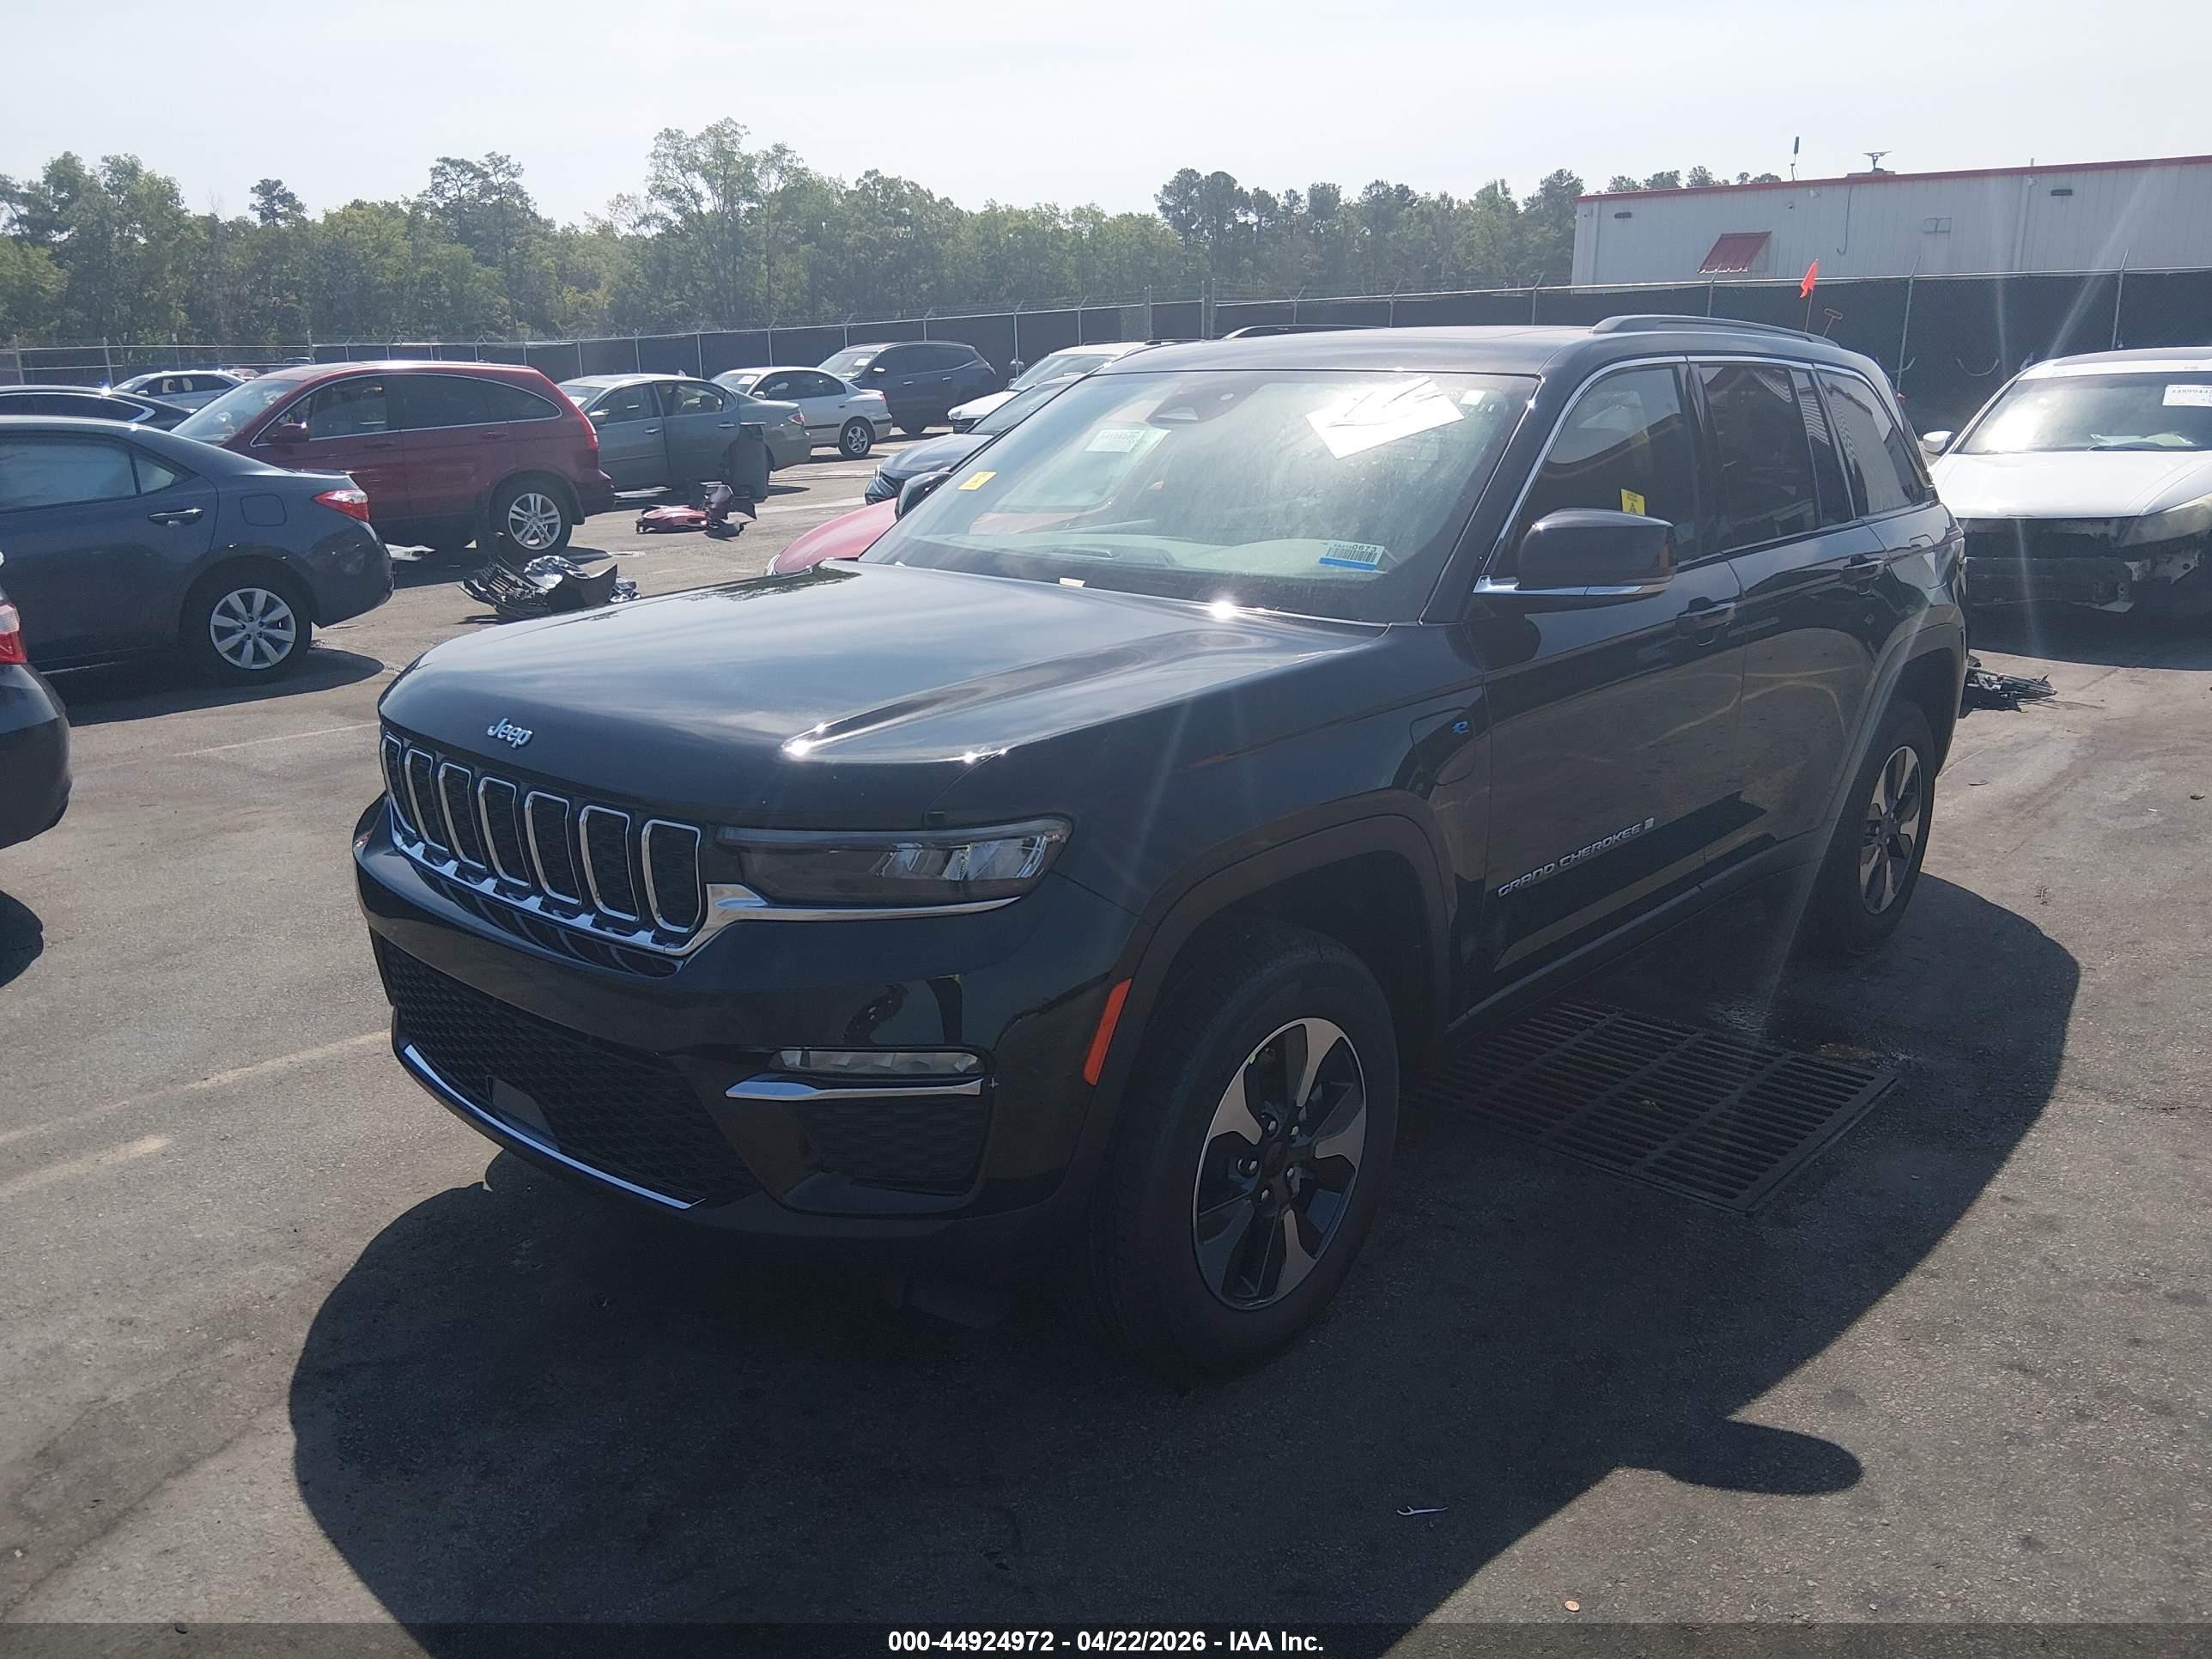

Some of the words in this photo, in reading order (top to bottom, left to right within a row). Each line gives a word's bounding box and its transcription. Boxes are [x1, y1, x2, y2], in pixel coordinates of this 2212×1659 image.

[487, 718, 532, 748] Jeep
[1498, 863, 1555, 898] GRAND
[1559, 823, 1642, 867] CHEROKEE
